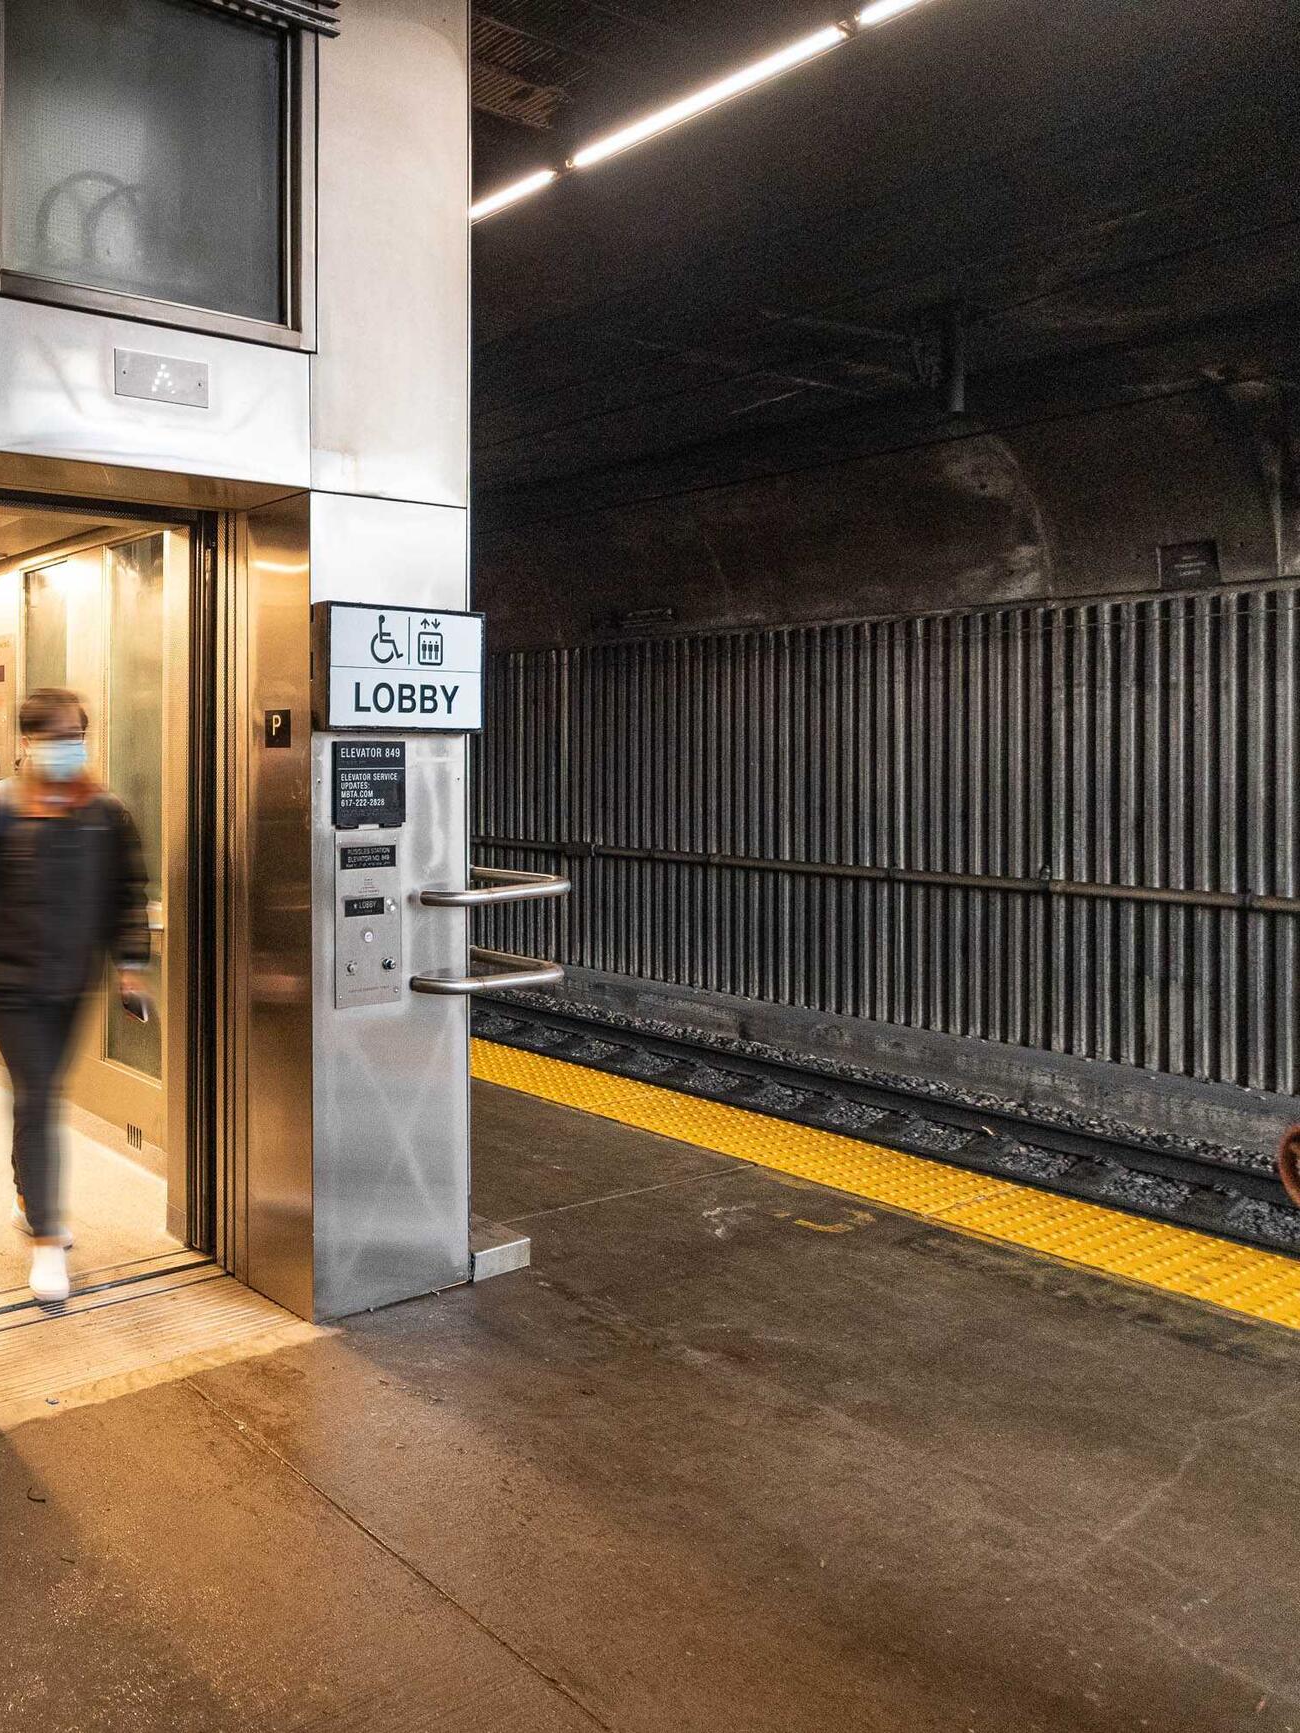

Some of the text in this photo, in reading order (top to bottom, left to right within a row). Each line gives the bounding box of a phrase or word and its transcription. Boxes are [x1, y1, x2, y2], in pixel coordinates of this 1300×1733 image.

[354, 682, 460, 715] LOBBY
[272, 714, 282, 737] P
[340, 747, 401, 758] ELEVATOR 849
[340, 772, 398, 782] ELEVATOR SERVICE
[340, 781, 371, 790] UPDATES:
[340, 790, 374, 799] MBTA.COM
[340, 798, 385, 807] 617-222-2828
